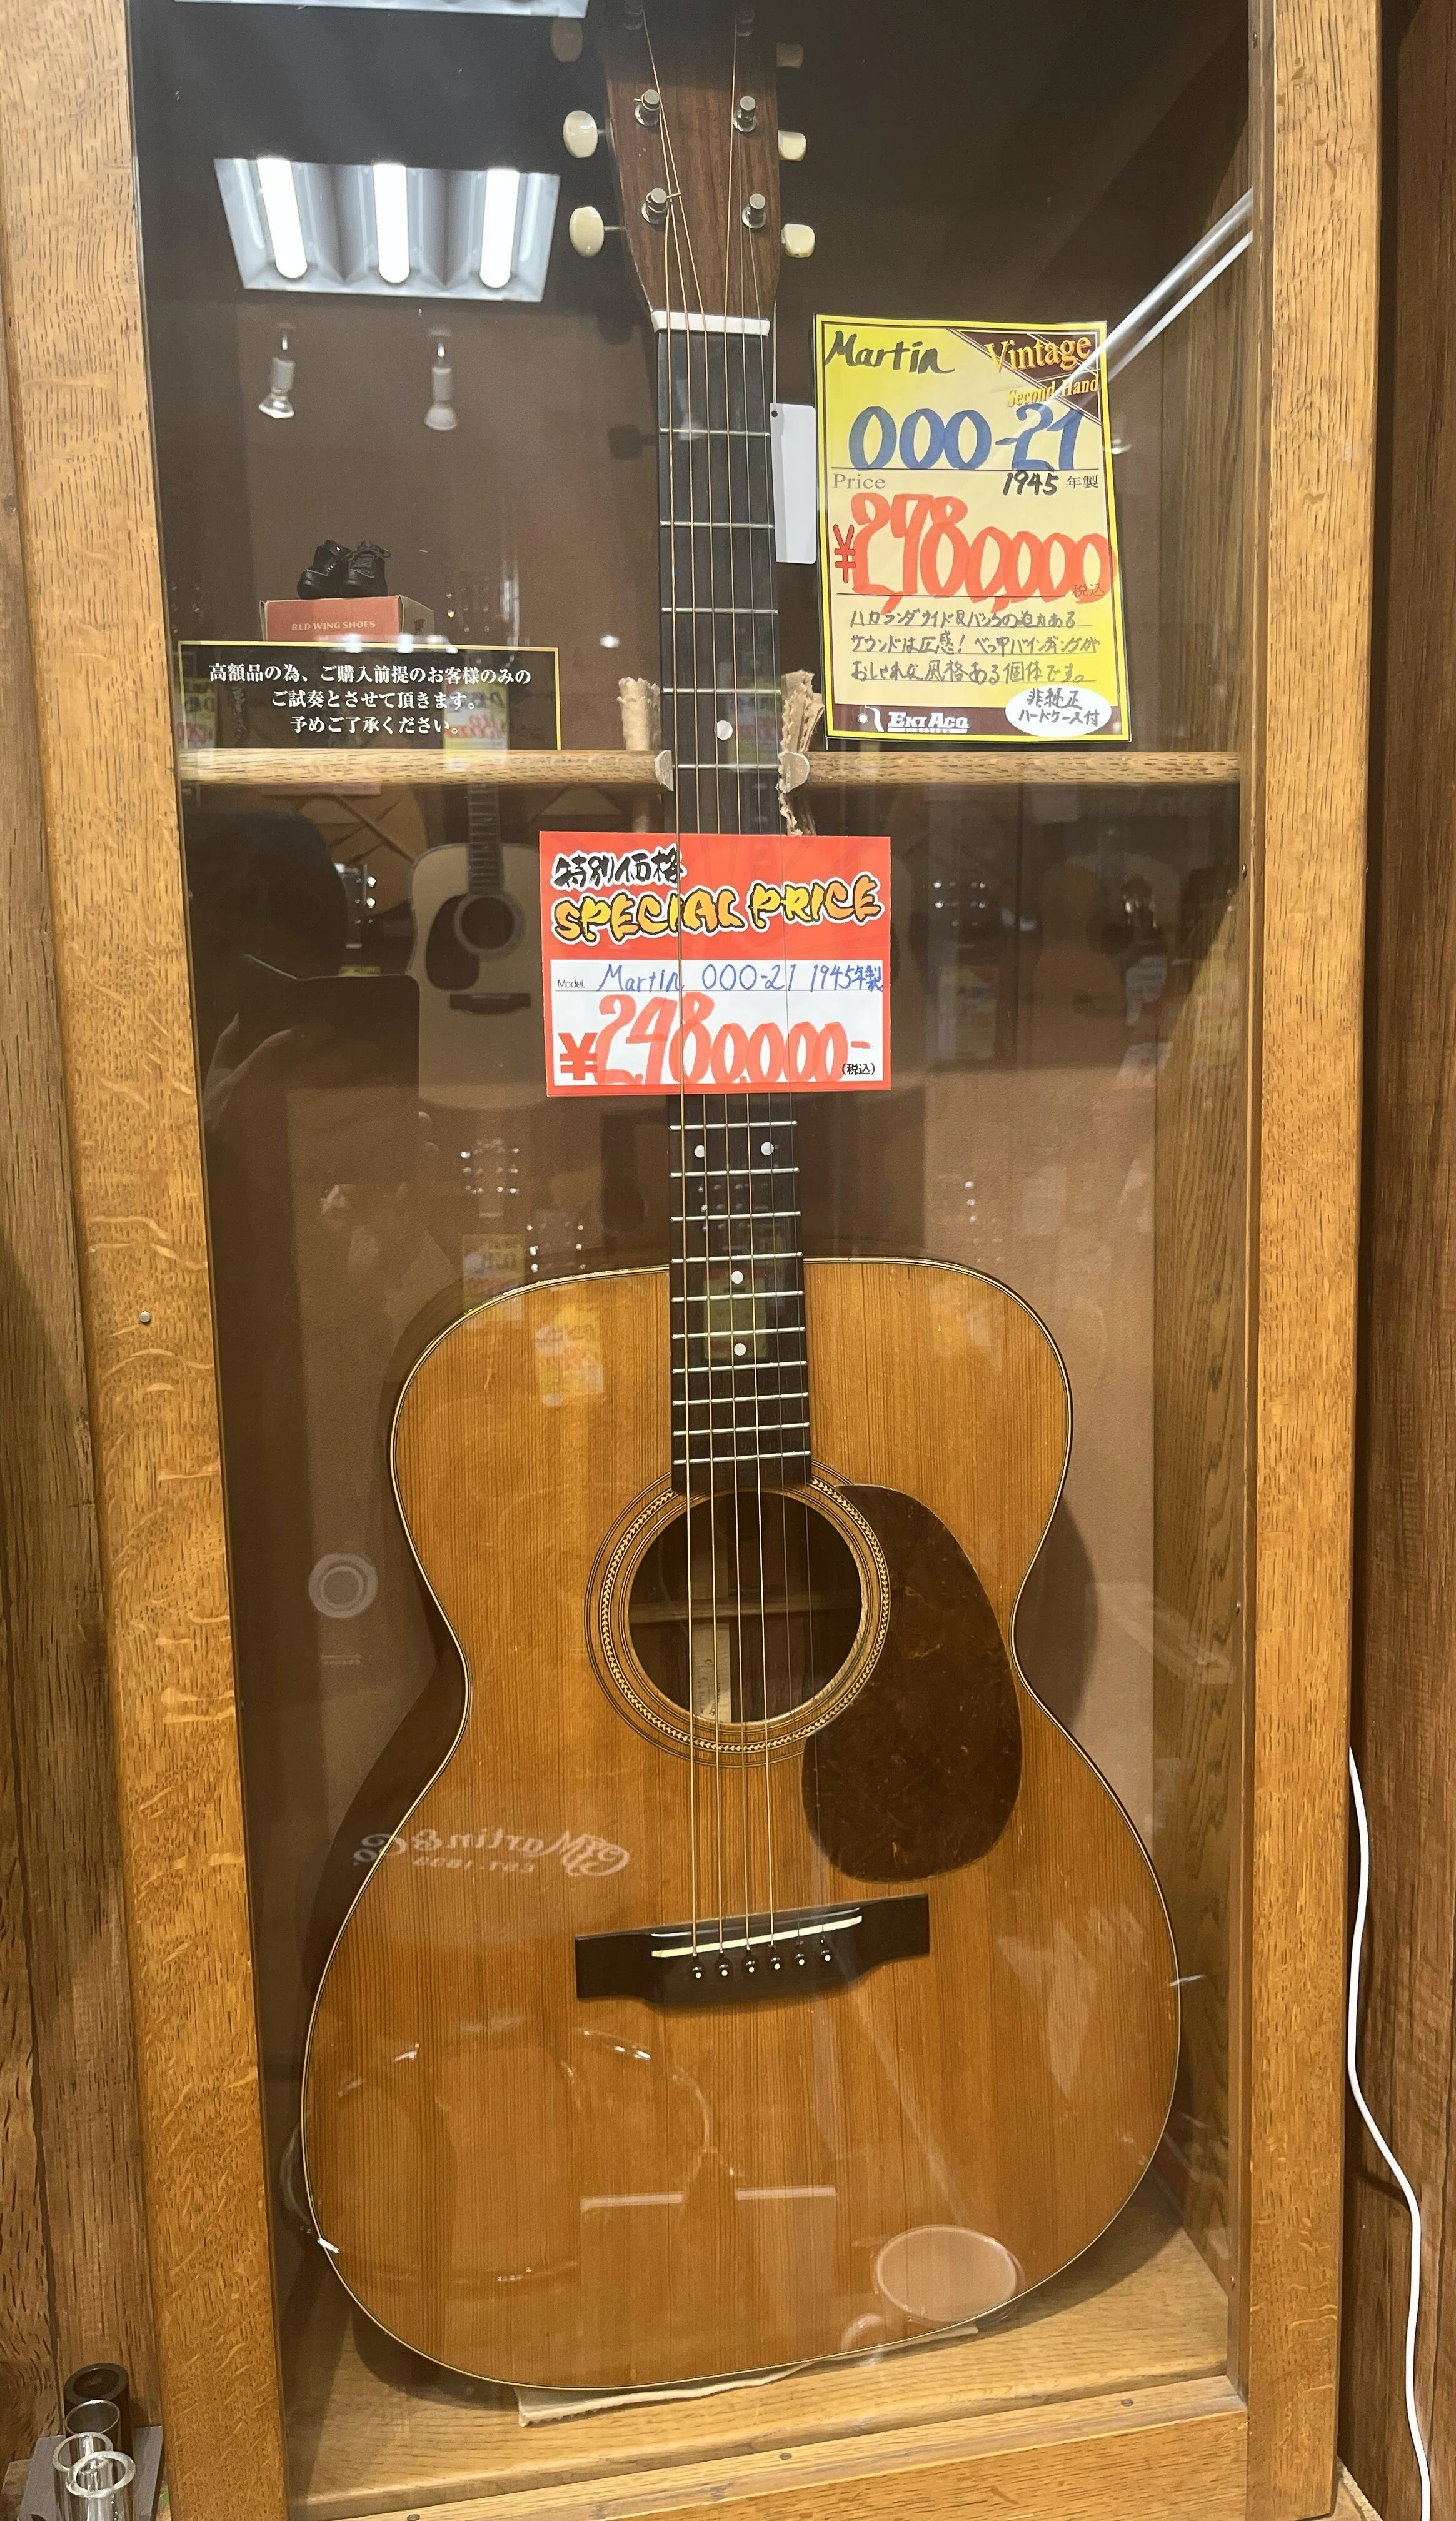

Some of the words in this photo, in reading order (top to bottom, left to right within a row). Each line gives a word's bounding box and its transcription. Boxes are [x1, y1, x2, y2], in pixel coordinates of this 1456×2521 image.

[824, 330, 955, 373] Martin
[984, 336, 1092, 373] Vintage
[1007, 380, 1055, 408] Second
[1061, 375, 1099, 396] Hand
[848, 403, 1085, 471] 000-21
[832, 474, 886, 490] Price
[1002, 472, 1058, 496] 1945
[1065, 475, 1098, 490] 年製
[1072, 583, 1106, 598] 税込
[292, 622, 311, 631] RED
[313, 621, 340, 630] WING
[342, 620, 376, 629] SHOES
[273, 688, 476, 710] ご試奏とさせて頂きます。
[1027, 687, 1083, 710] 非純正
[291, 715, 459, 735] 予めご了承ください。
[1018, 708, 1100, 727] ハードケース付
[555, 845, 684, 888] 特別価格
[554, 888, 746, 943] SPECIAL
[749, 873, 883, 929] PRICE
[558, 979, 585, 989] Model
[597, 963, 684, 992] Martin
[701, 964, 796, 992] 000-21
[811, 964, 883, 992] 1945年製
[841, 1062, 875, 1077] (税込)
